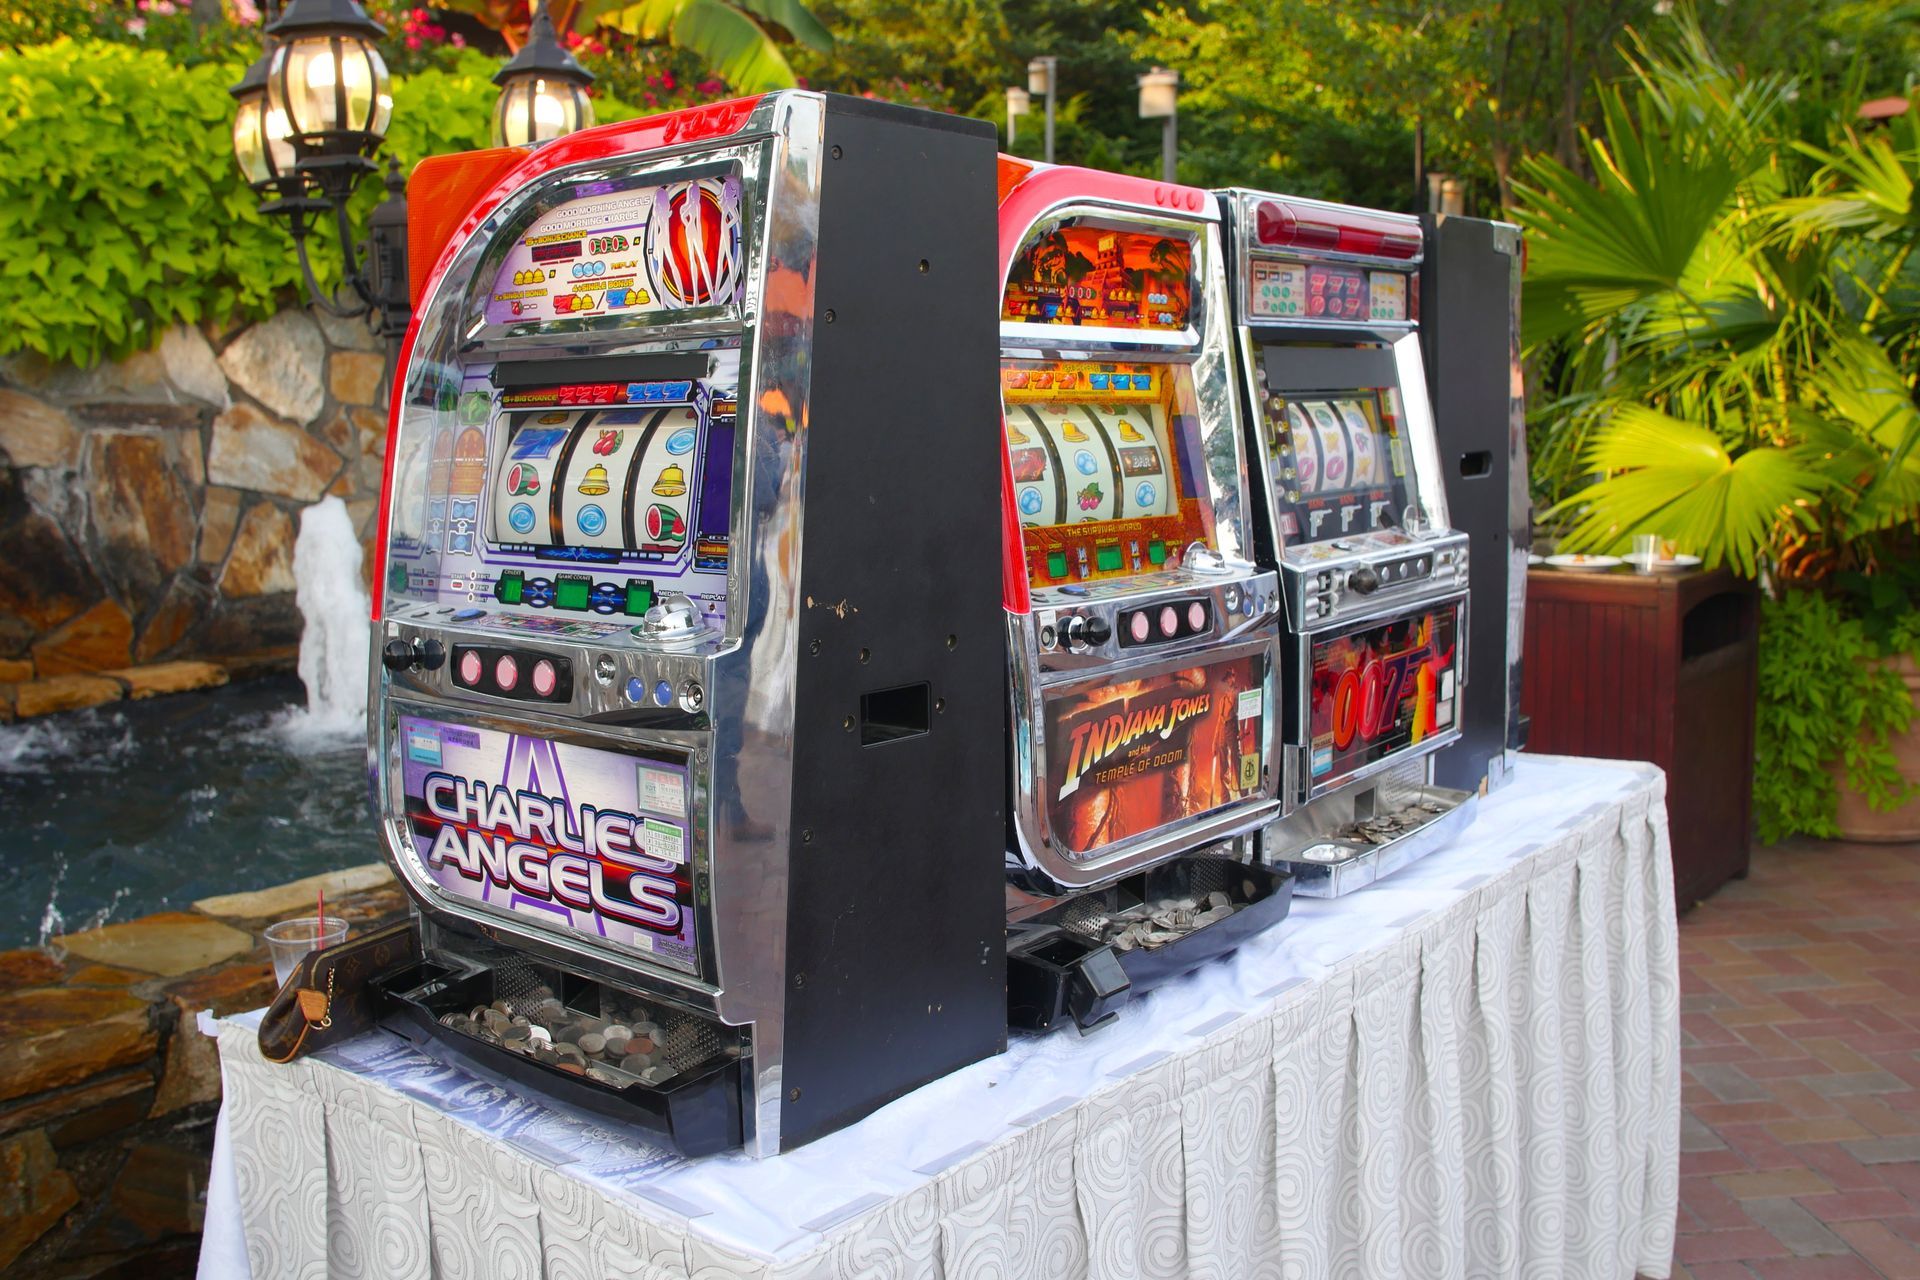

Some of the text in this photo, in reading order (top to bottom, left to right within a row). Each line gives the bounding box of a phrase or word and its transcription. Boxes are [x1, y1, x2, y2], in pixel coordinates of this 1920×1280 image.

[556, 196, 651, 219] GOOD MORNING ANGELS
[540, 211, 639, 233] GOOD MORNING CHARLIE
[610, 260, 638, 270] REPLAY
[607, 278, 634, 288] BONUS
[1066, 523, 1142, 537] THE SURVIVAL WORLD
[700, 593, 726, 601] REPLAY
[1332, 644, 1430, 751] 007
[1058, 704, 1166, 802] INDIANA
[1160, 694, 1210, 740] JONES
[1128, 743, 1151, 758] and the
[1095, 749, 1183, 785] TEMPLE OF DOOM
[427, 823, 683, 935] ANGELS
